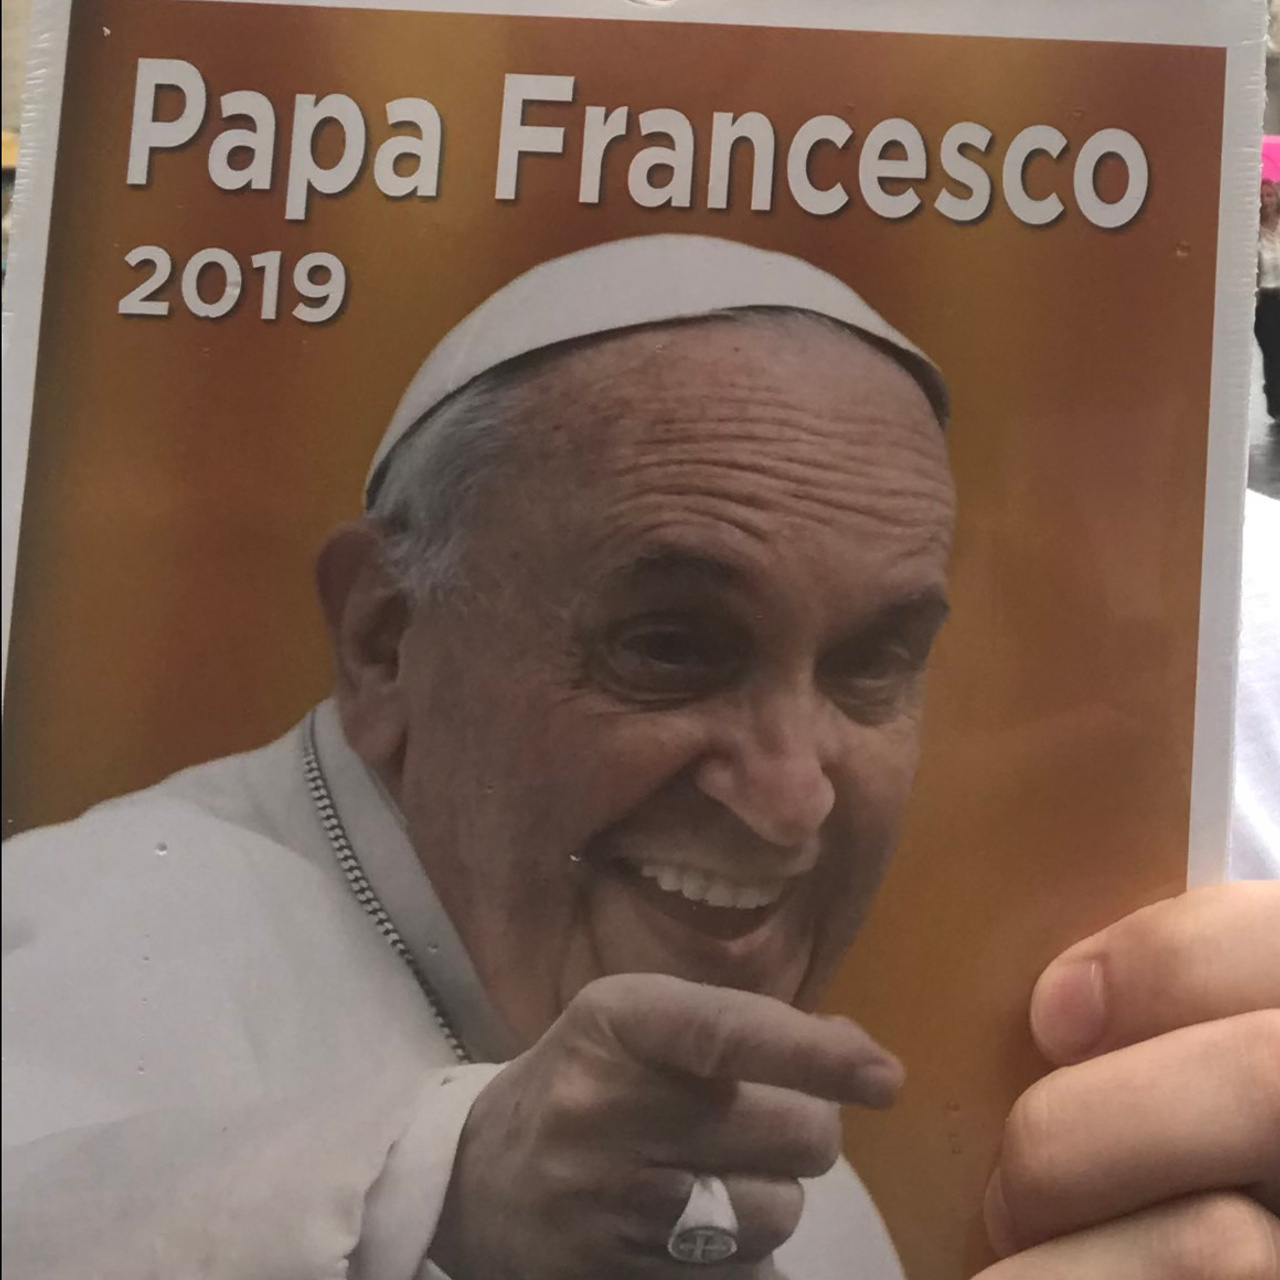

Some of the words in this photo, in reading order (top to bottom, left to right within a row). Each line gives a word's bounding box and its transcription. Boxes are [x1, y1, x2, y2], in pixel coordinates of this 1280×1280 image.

[125, 56, 443, 222] Papa
[494, 72, 1150, 230] Francesco
[116, 244, 347, 324] 2019
